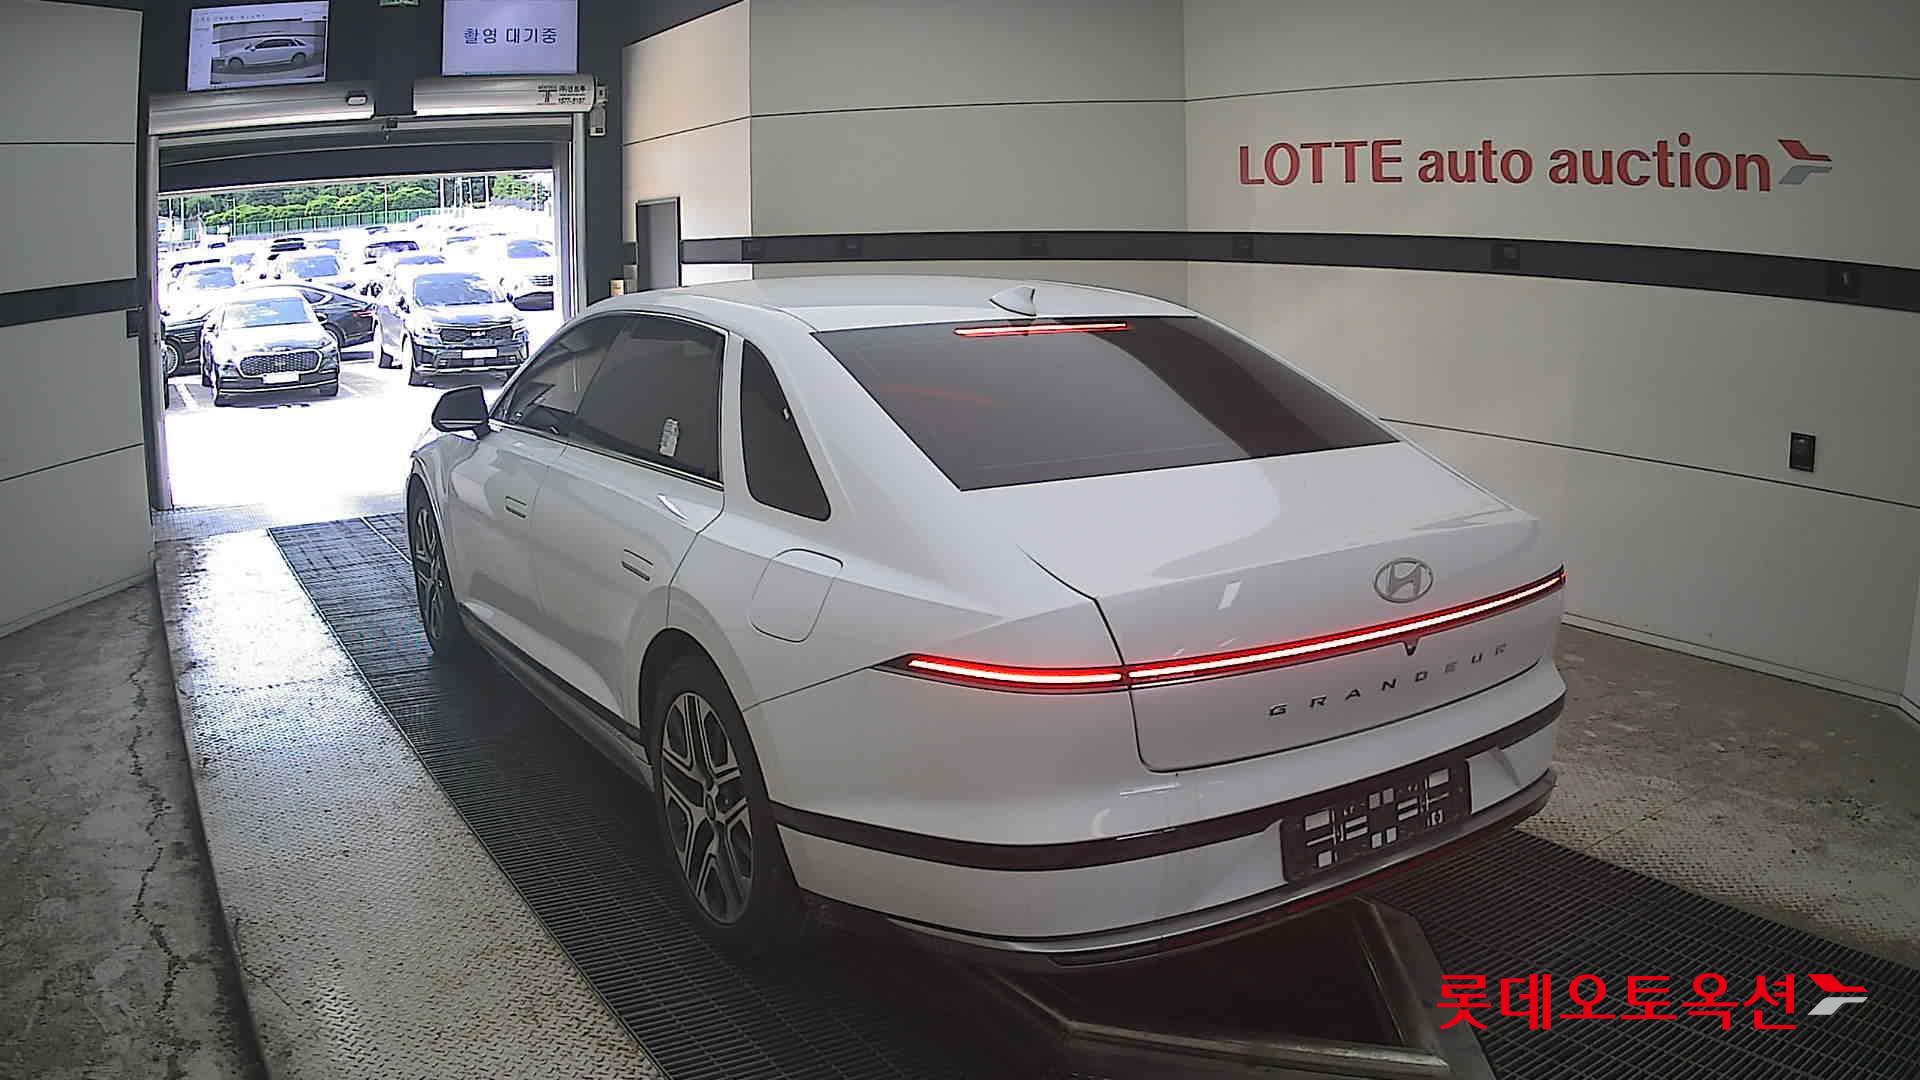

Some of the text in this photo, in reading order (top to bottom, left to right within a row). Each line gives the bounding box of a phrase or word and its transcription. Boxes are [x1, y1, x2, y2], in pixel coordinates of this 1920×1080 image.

[463, 27, 558, 45] 촬영 대기중
[1238, 132, 1772, 192] LOTTE auto auction
[1268, 642, 1508, 717] GRANDEUR
